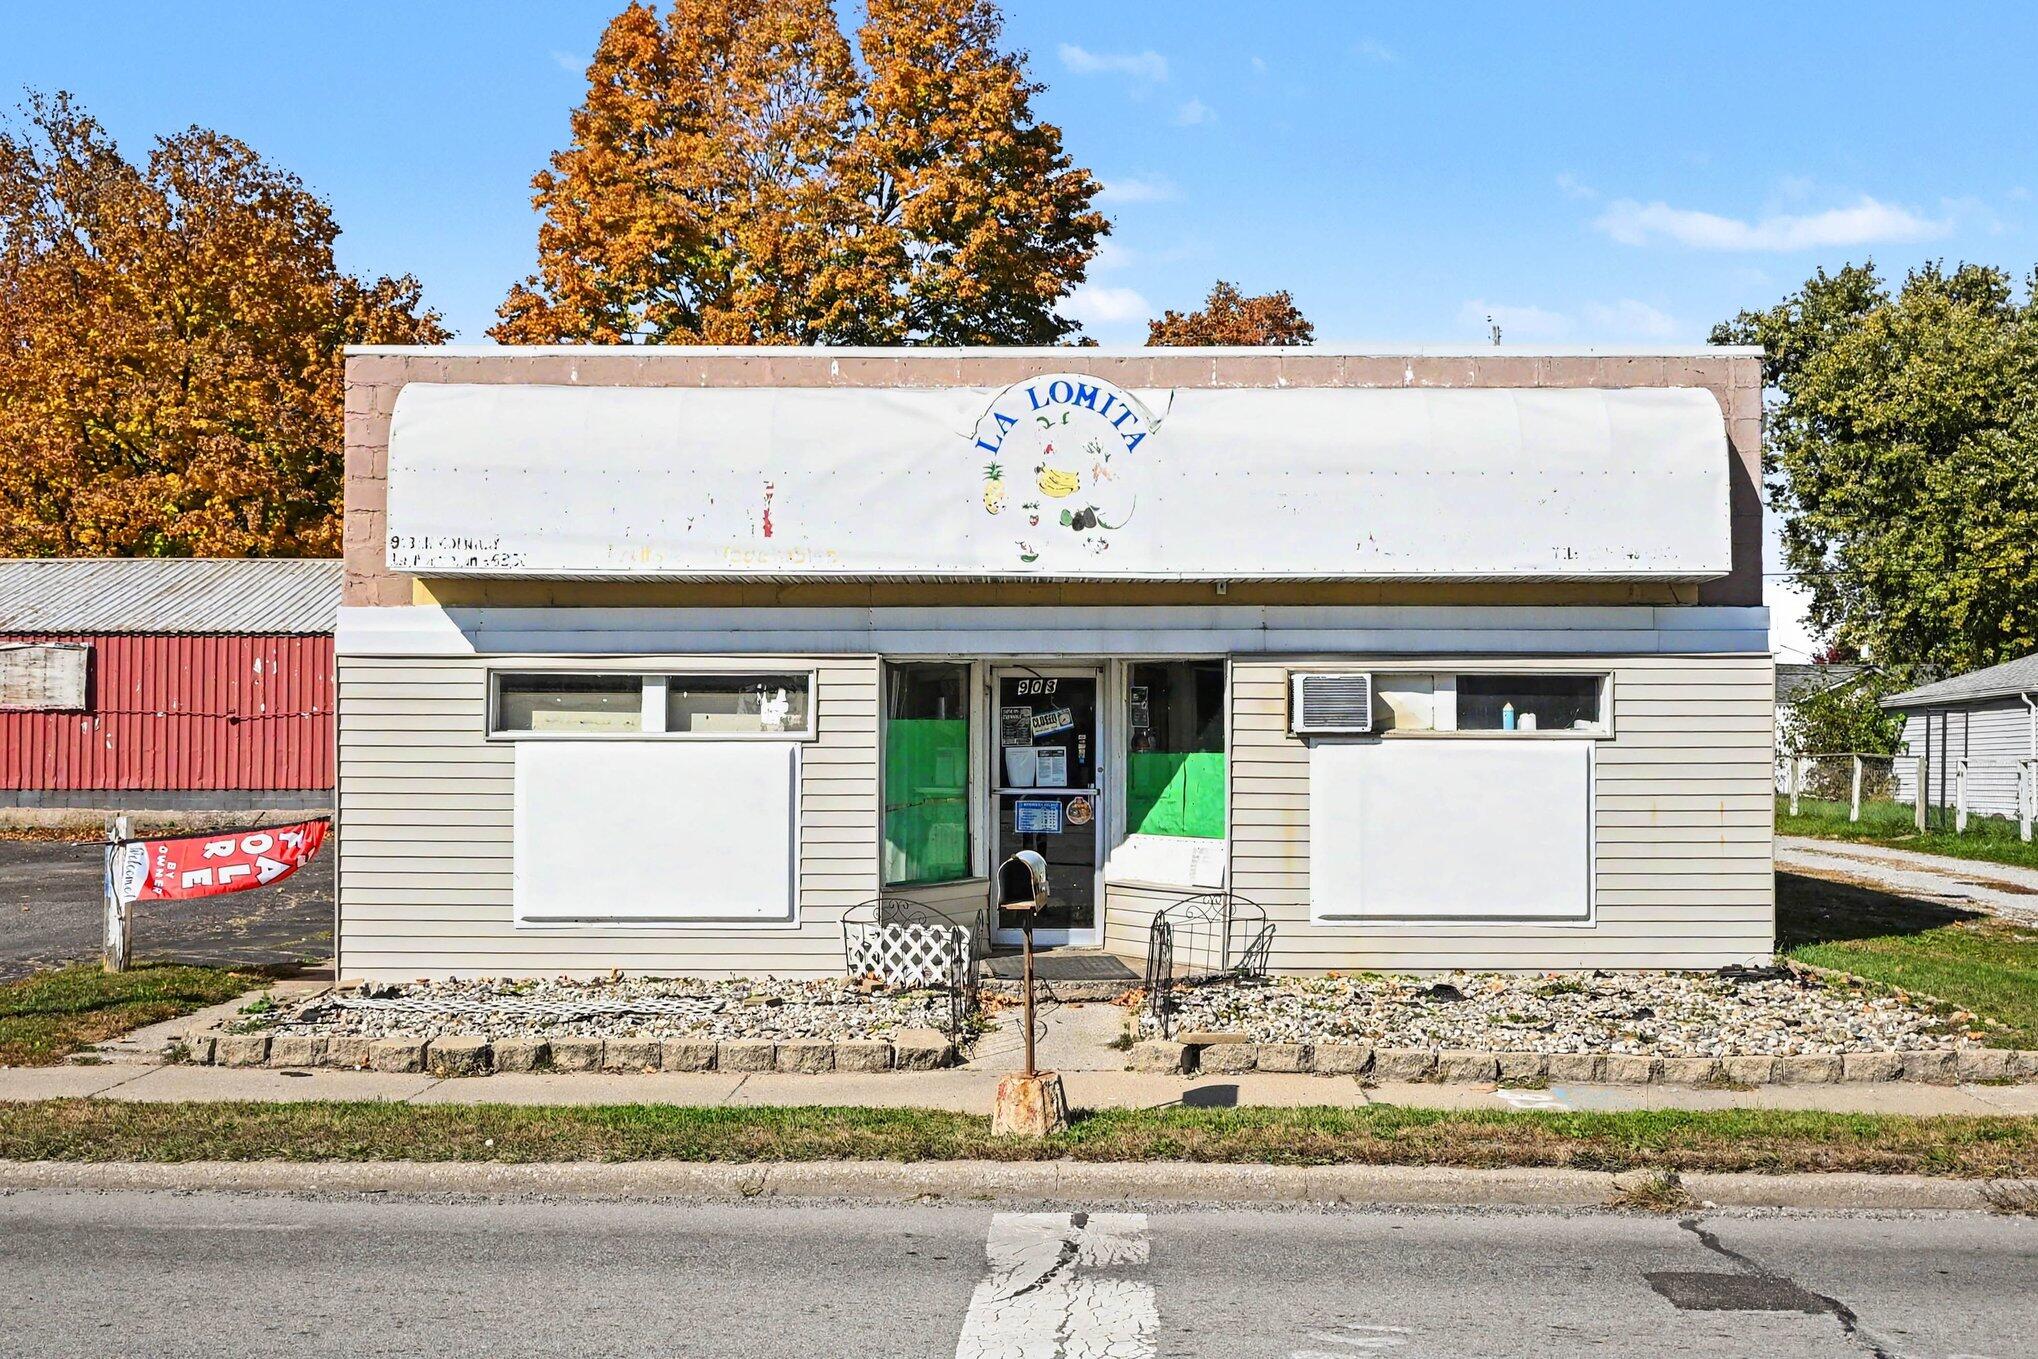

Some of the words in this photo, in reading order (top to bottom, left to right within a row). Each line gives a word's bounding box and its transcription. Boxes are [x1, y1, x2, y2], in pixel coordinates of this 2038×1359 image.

[975, 412, 1018, 455] LA
[1025, 380, 1147, 453] LOMITA
[1018, 680, 1056, 694] 903
[202, 830, 304, 859] FOR
[153, 844, 169, 895] OWNER
[166, 861, 177, 879] BY
